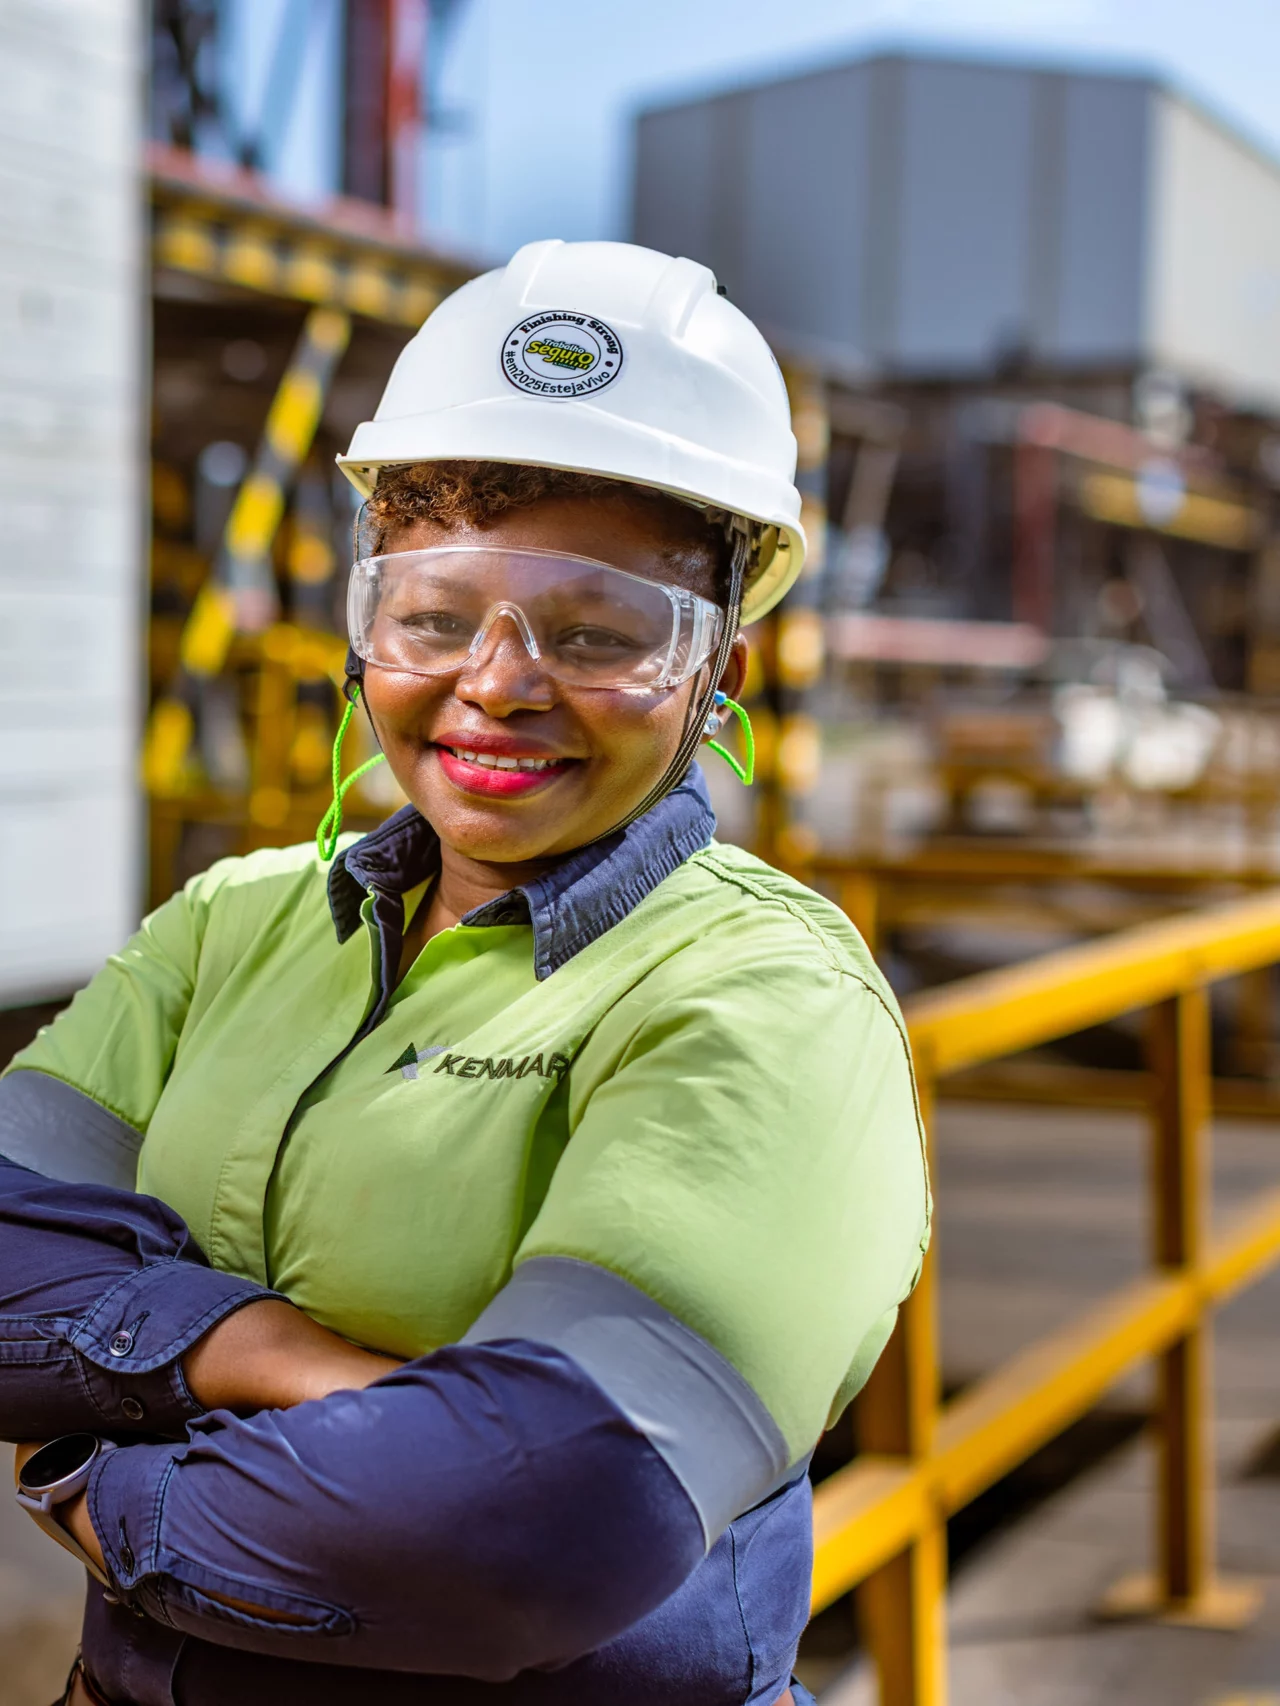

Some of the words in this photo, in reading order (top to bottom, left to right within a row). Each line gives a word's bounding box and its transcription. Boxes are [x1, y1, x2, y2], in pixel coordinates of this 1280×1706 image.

[519, 313, 586, 334] Finishing
[587, 320, 619, 354] Strong
[544, 339, 585, 354] Trabalho
[505, 350, 610, 394] #em2025EstejaVivo
[433, 1053, 570, 1080] KENMAR
